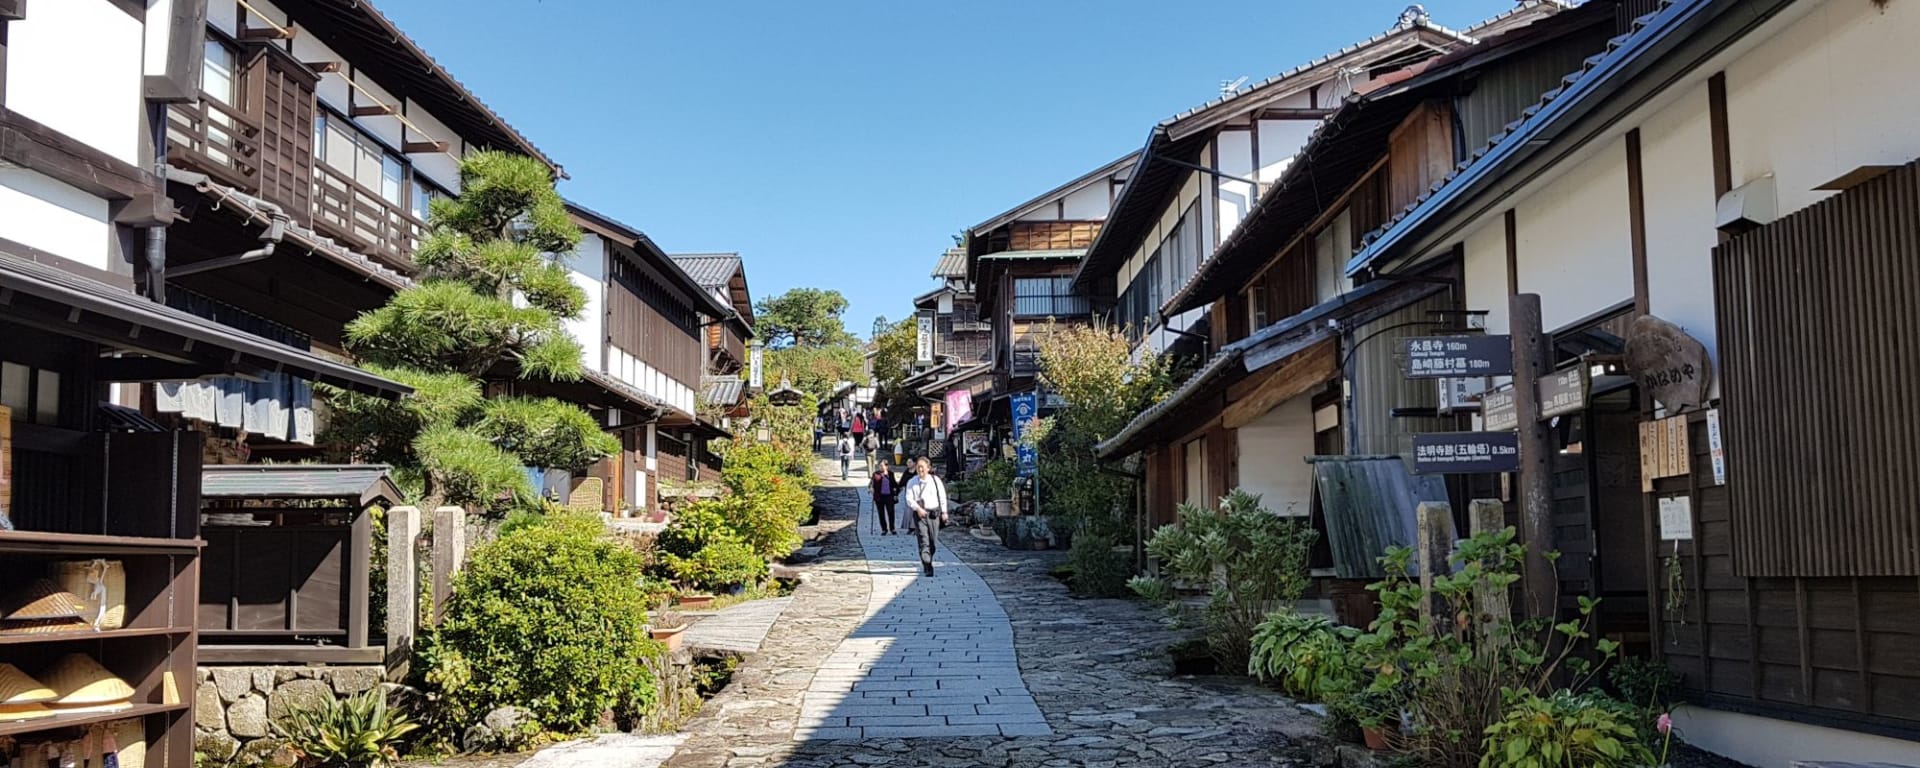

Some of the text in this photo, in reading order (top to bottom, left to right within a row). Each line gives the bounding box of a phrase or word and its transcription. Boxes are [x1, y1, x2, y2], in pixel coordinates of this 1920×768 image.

[1411, 340, 1443, 351] 永昌寺
[1412, 358, 1467, 369] 島崎藤村墓
[1492, 446, 1516, 455] 0.5km
